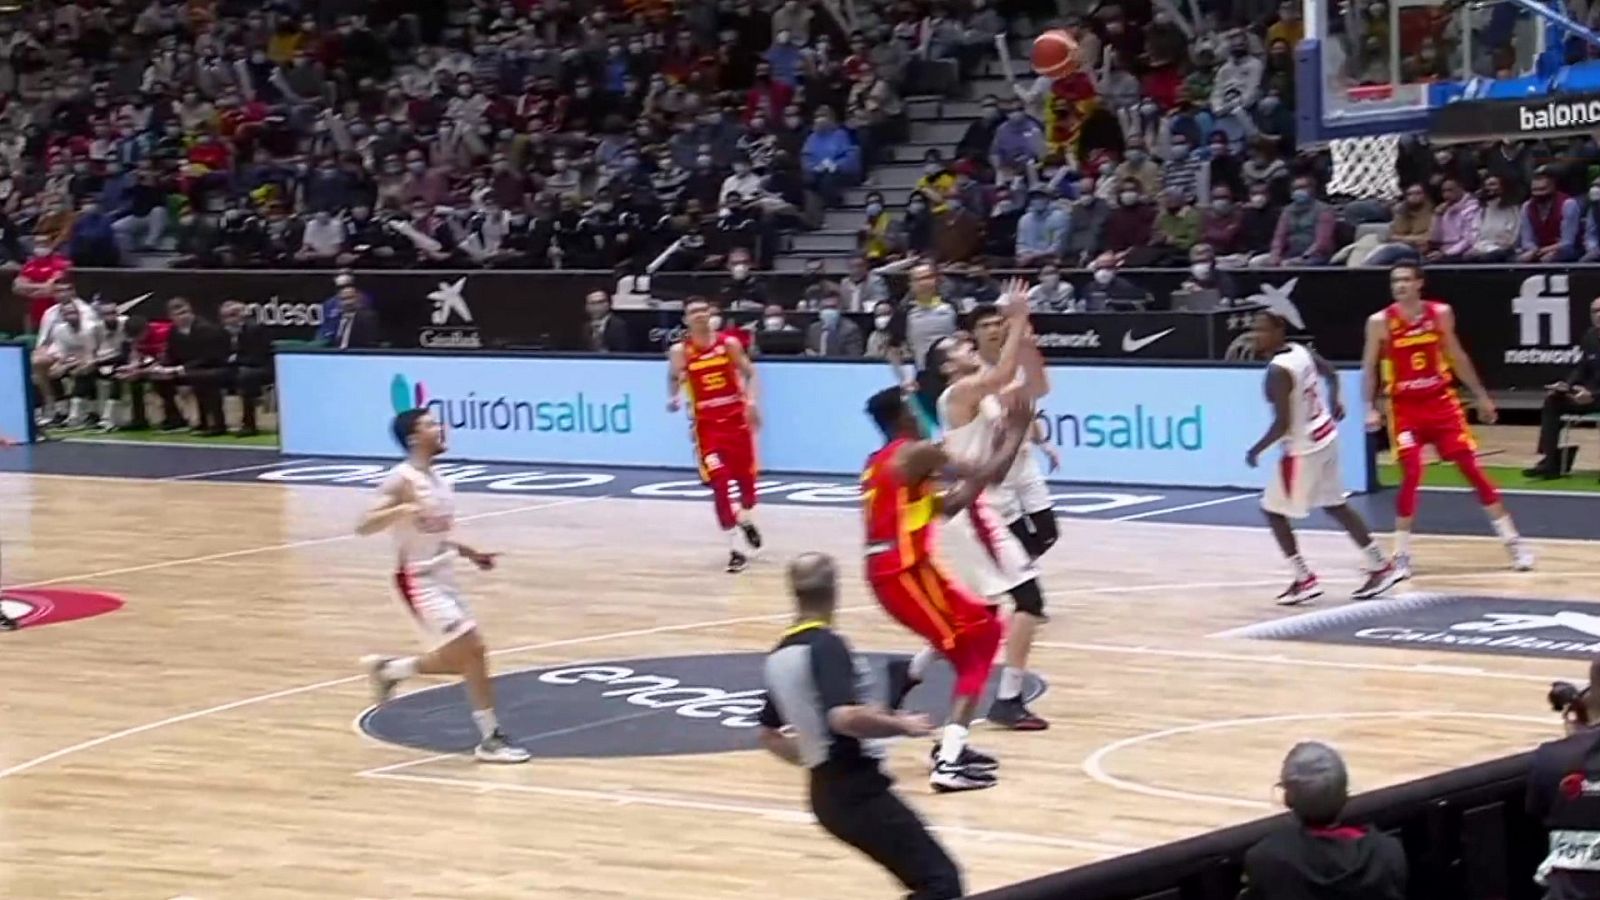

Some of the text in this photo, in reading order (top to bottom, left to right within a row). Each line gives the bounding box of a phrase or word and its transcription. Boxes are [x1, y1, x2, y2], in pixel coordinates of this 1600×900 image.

[243, 295, 324, 326] ndesa
[1511, 274, 1569, 346] fi
[1410, 351, 1427, 371] 6
[1035, 404, 1204, 451] ónsalud
